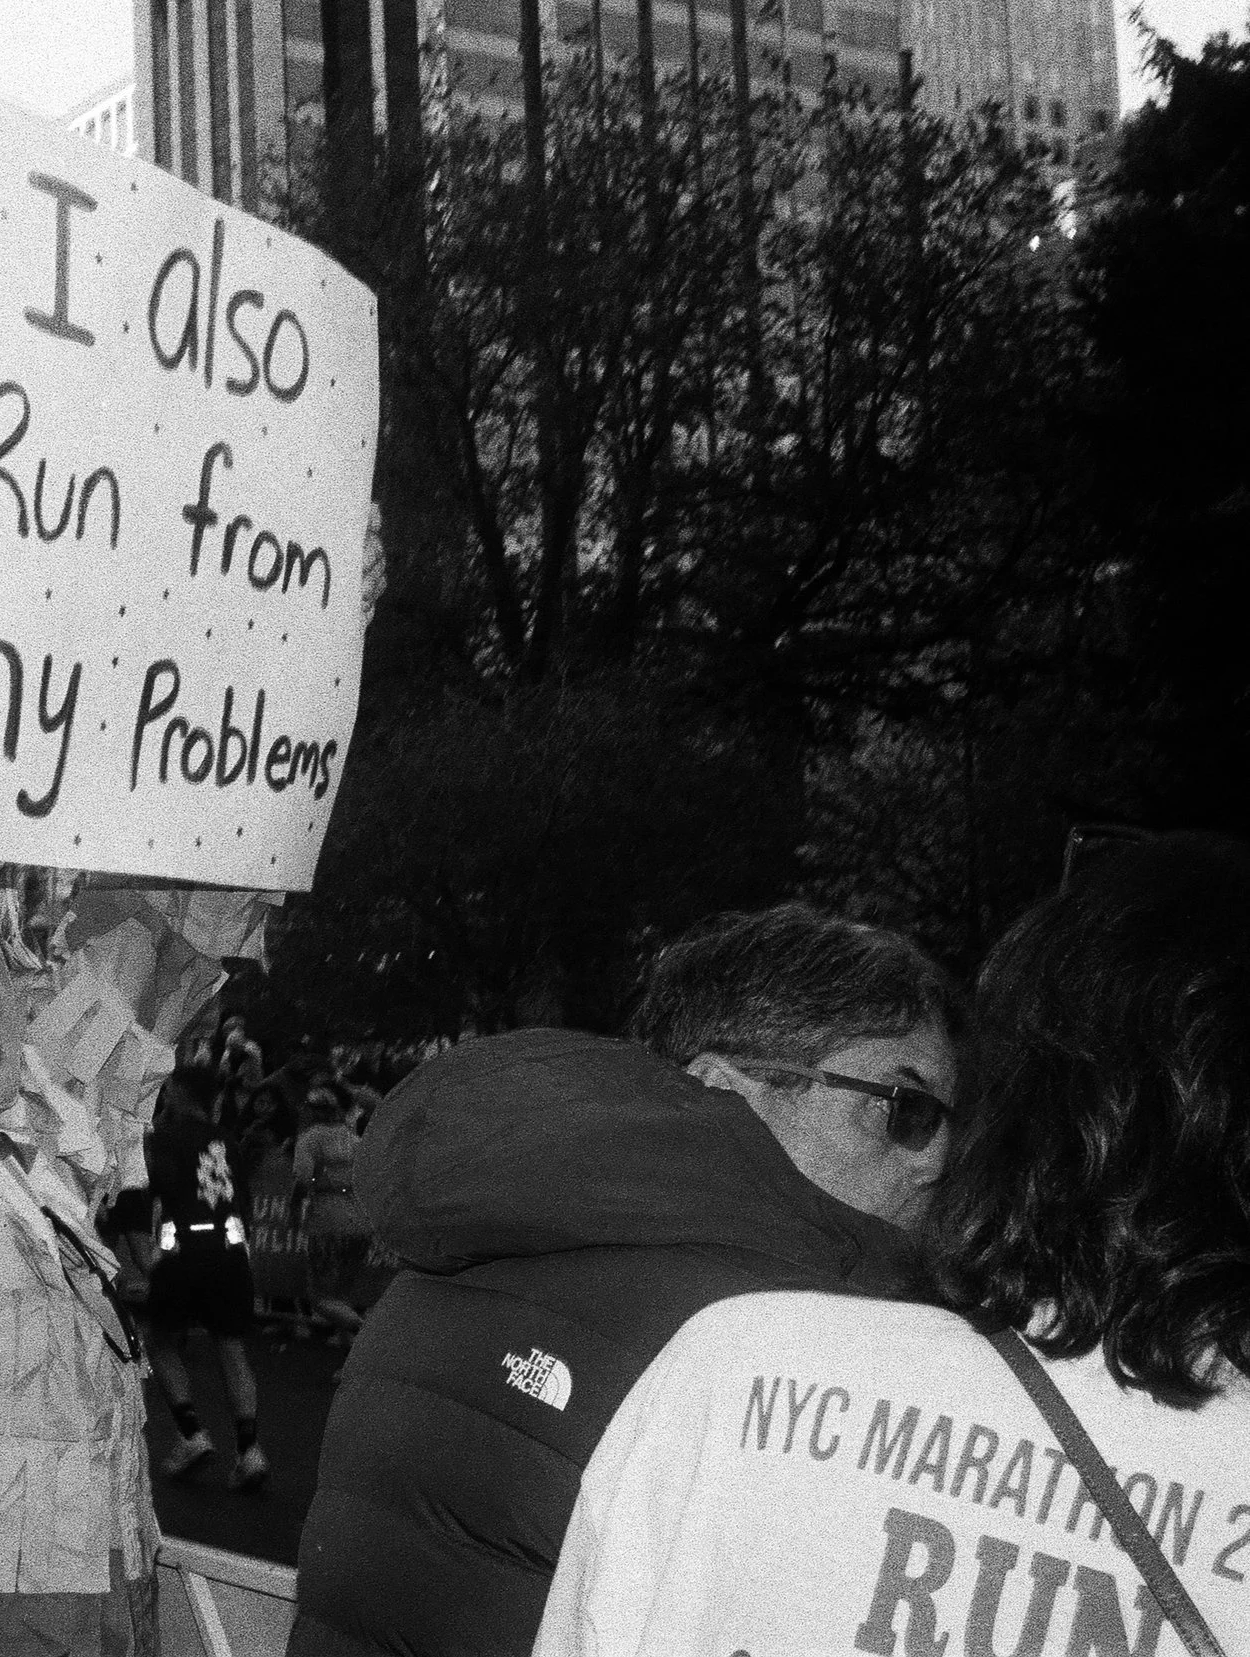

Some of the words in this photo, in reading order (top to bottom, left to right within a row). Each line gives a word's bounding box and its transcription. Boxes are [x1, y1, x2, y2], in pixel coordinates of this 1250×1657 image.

[24, 170, 98, 346] I
[148, 218, 310, 401] also
[182, 442, 331, 608] from
[130, 658, 339, 797] Problems
[501, 1352, 550, 1384] NORTH
[506, 1370, 542, 1398] FACE
[529, 1348, 556, 1371] THE
[740, 1375, 850, 1461] NYC
